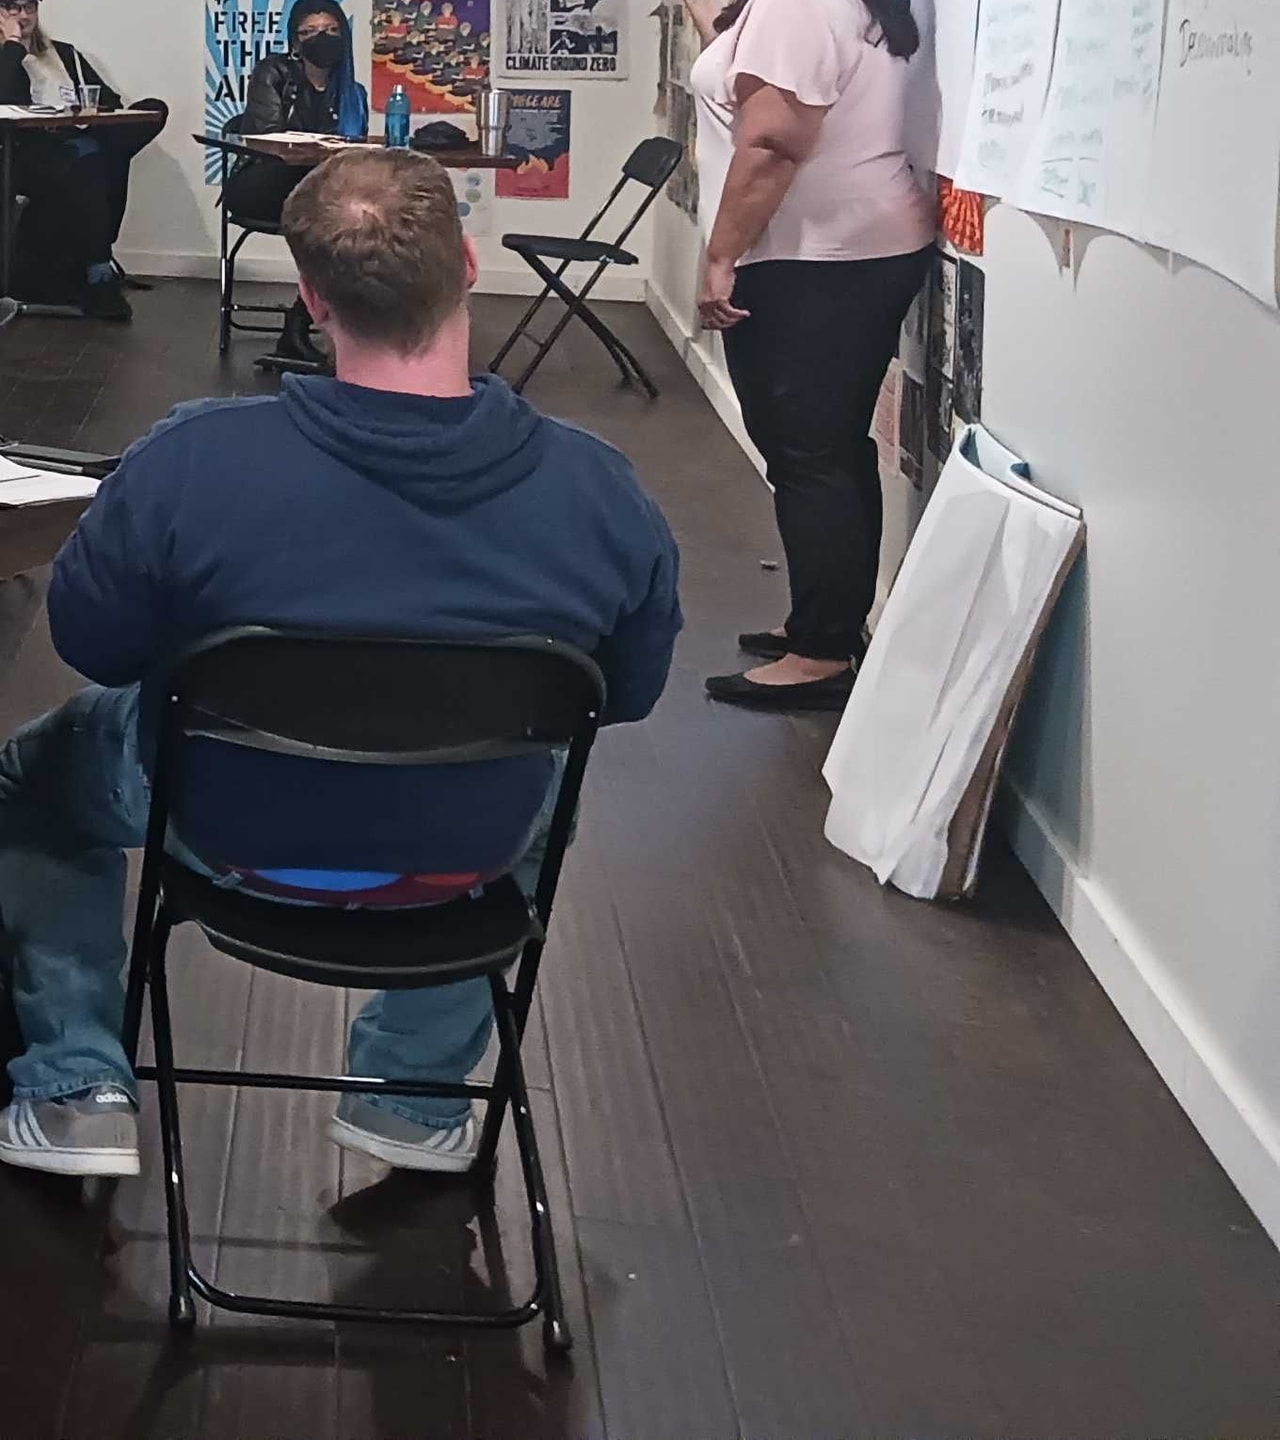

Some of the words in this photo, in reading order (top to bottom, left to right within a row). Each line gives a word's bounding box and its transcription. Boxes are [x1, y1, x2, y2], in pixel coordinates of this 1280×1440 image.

[214, 11, 283, 33] FREE
[505, 56, 549, 70] CLIMATE
[551, 57, 588, 71] GROUND
[590, 57, 616, 71] ZERO
